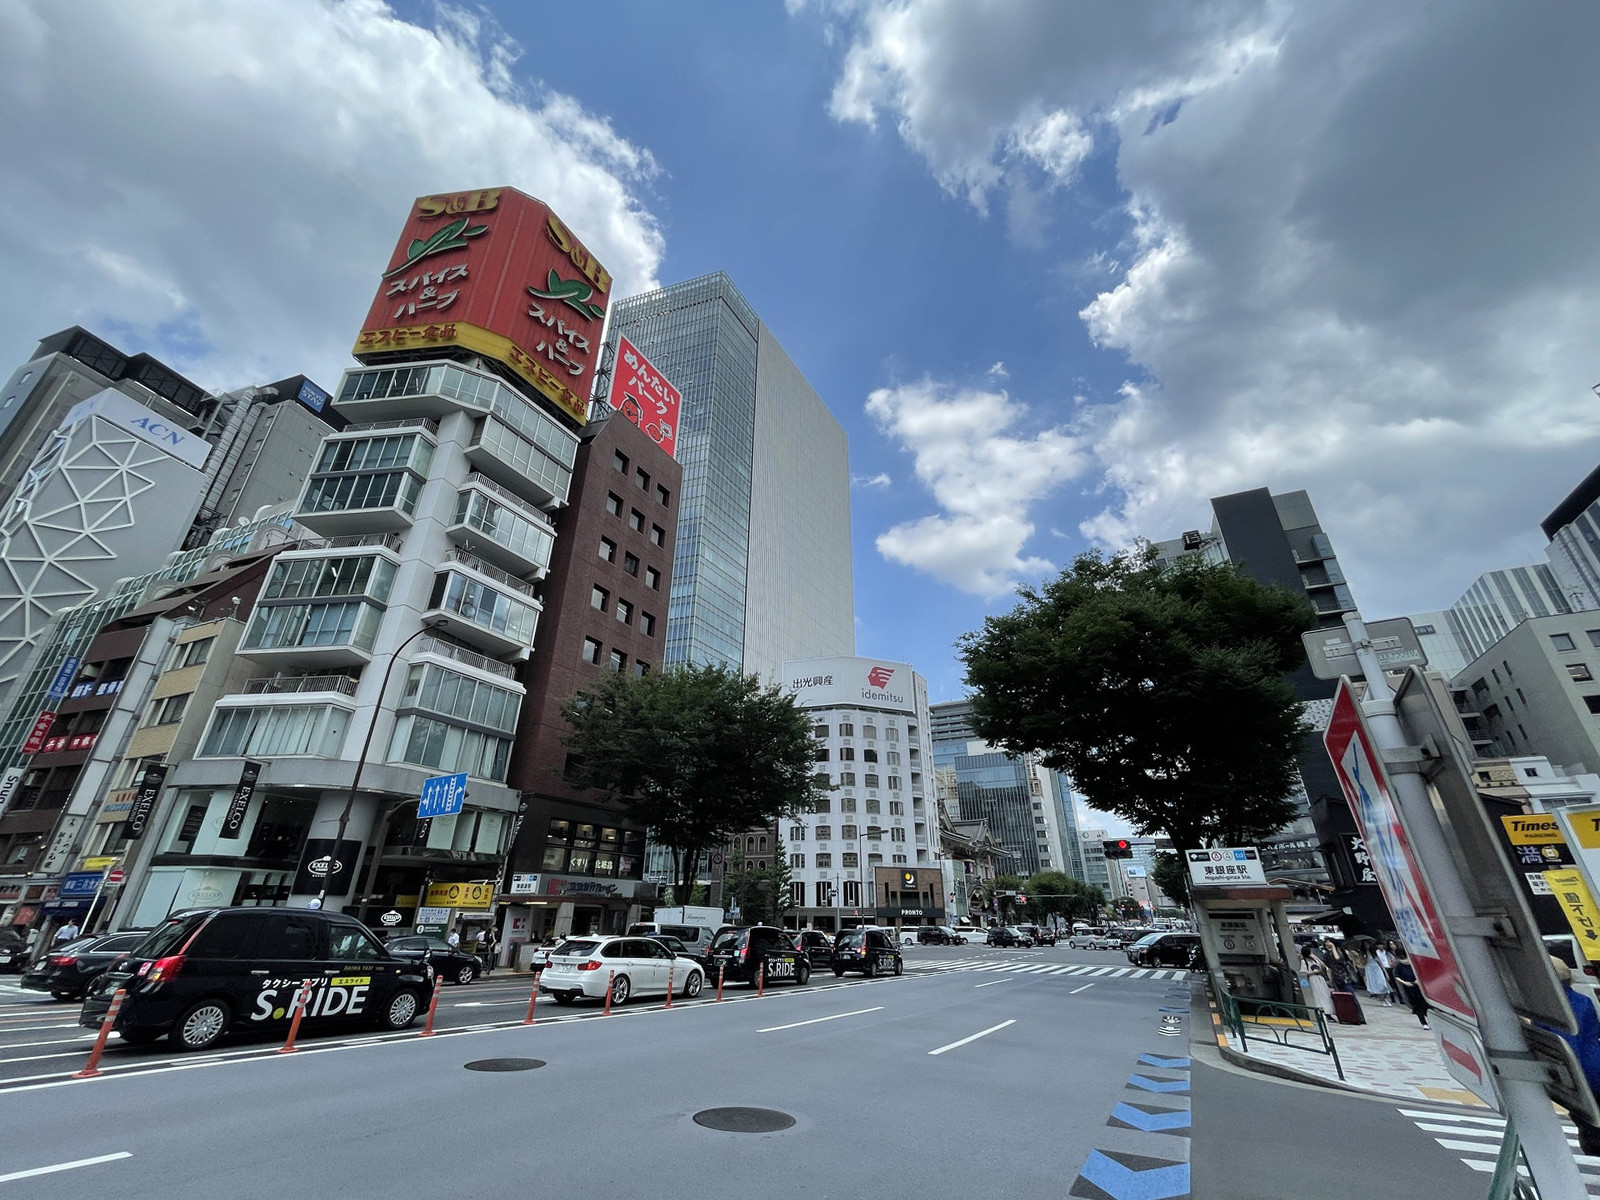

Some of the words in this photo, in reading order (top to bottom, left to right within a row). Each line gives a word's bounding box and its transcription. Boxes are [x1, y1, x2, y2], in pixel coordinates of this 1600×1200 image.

[416, 189, 500, 219] S&B
[545, 215, 609, 294] S&B
[360, 323, 456, 344] エスビー食品
[510, 345, 584, 417] エスビー食品
[624, 349, 675, 405] めんたい
[302, 390, 322, 407] STAY
[628, 376, 668, 414] パーク
[131, 417, 185, 446] ACN
[792, 675, 834, 689] 出光興産
[861, 688, 904, 704] idemitsu
[132, 789, 156, 830] EXELCO
[229, 786, 251, 830] EXELCO
[1511, 821, 1560, 831] Times
[1204, 865, 1248, 875] 東銀座駅
[262, 978, 328, 989] タクシーアプリ
[250, 986, 369, 1020] S.RIDE
